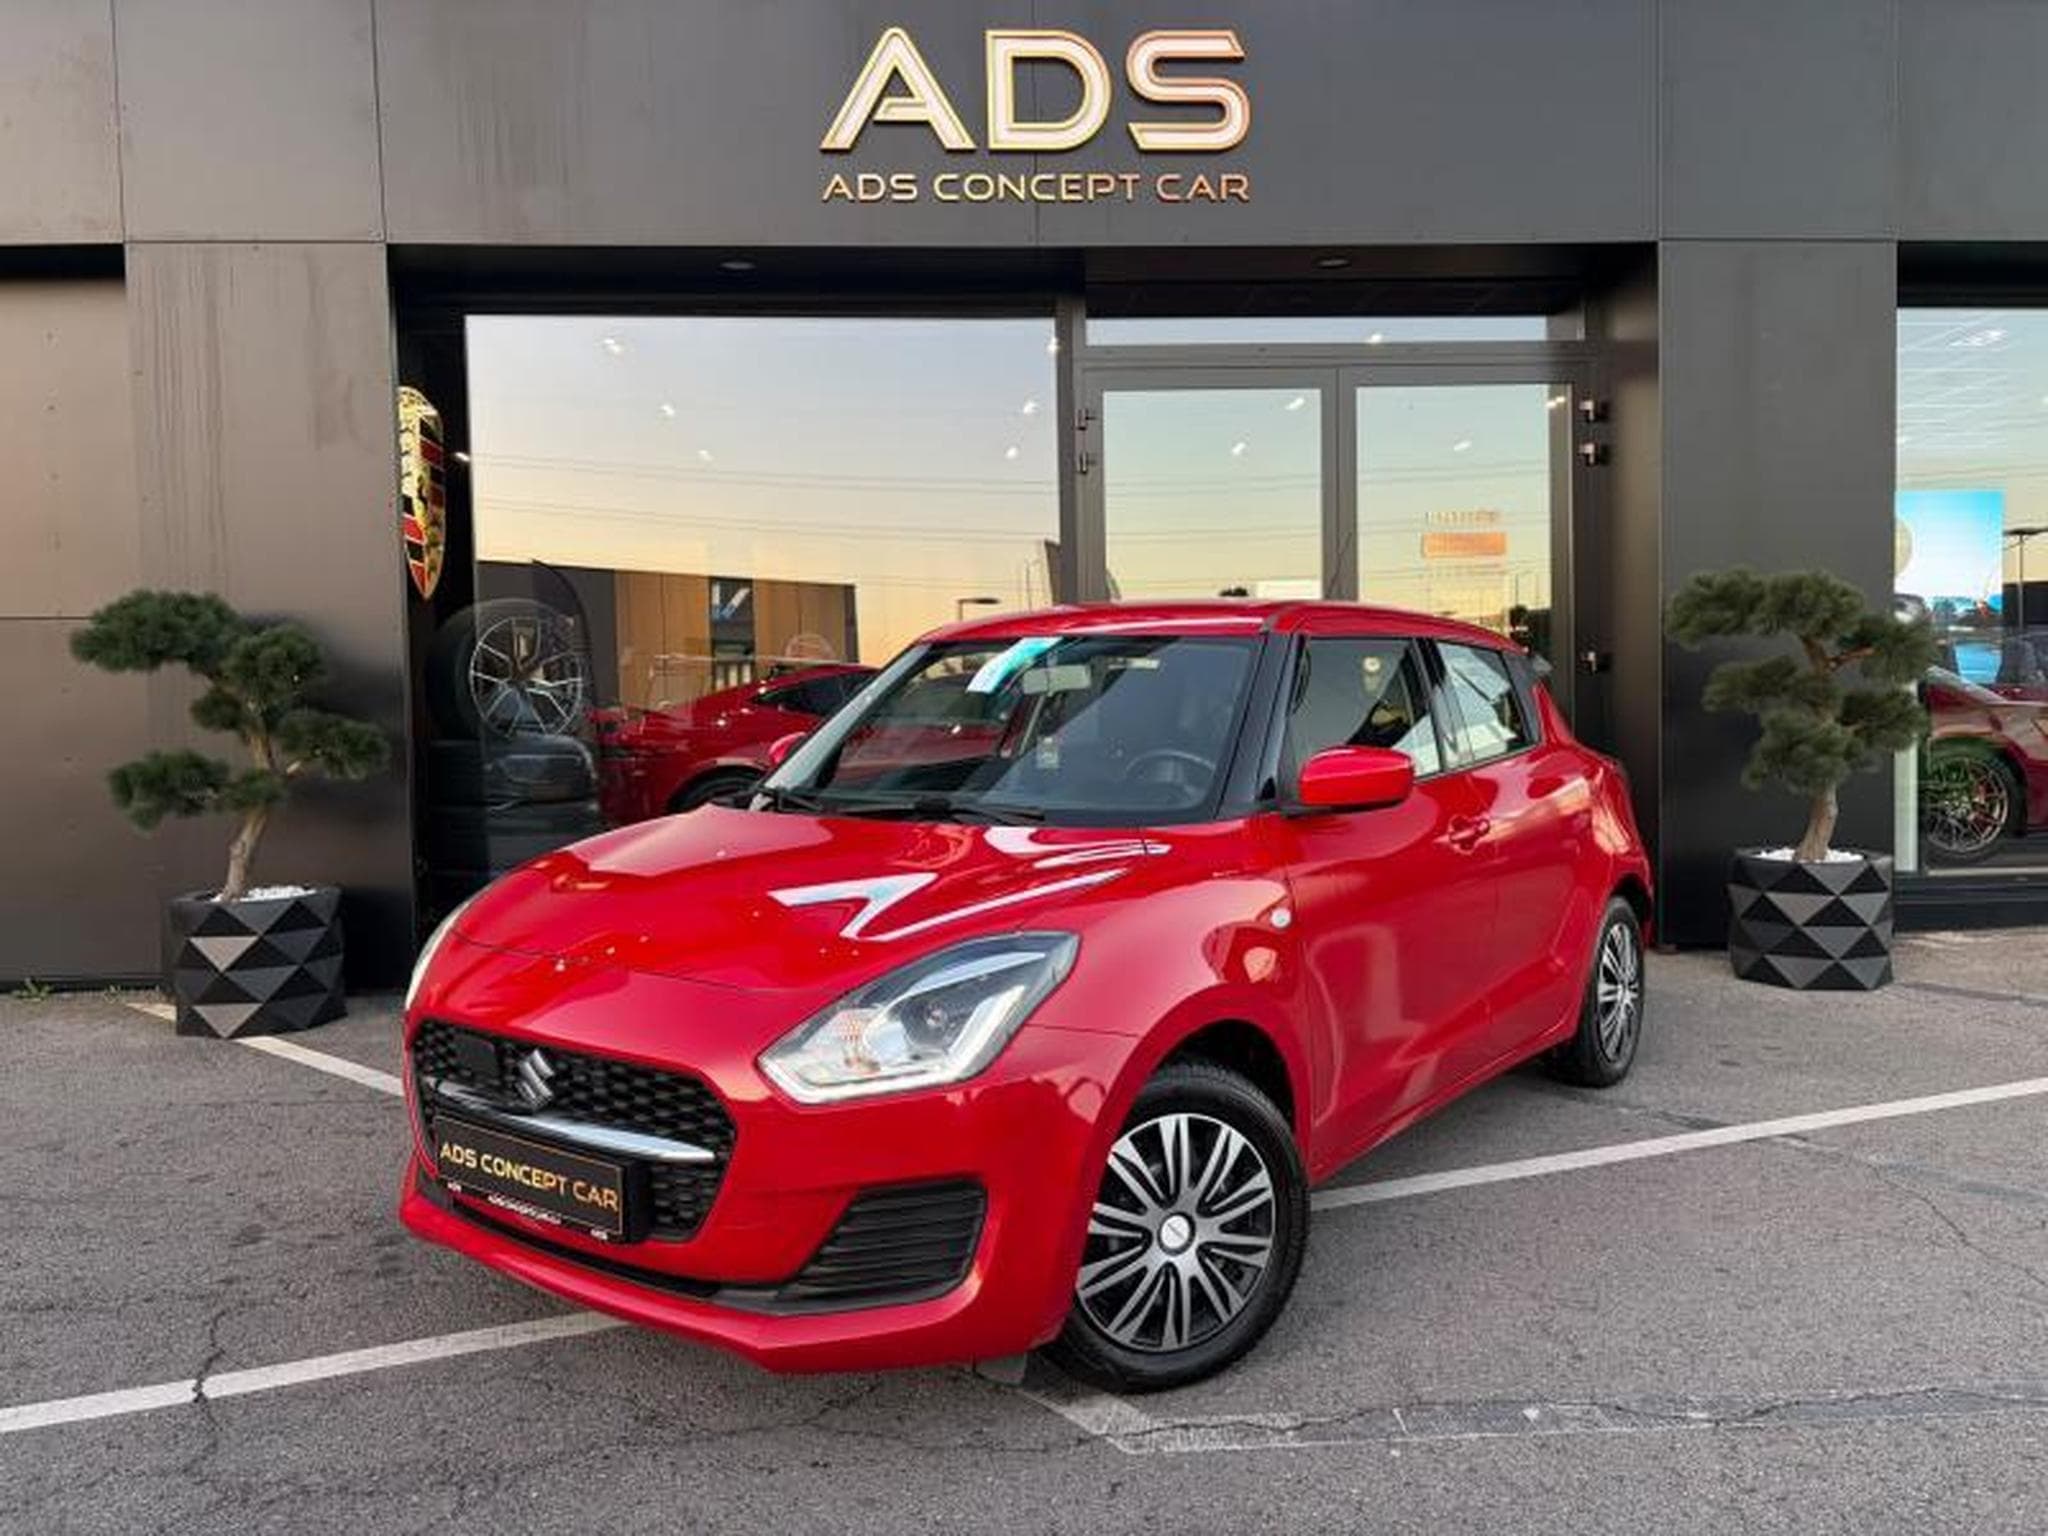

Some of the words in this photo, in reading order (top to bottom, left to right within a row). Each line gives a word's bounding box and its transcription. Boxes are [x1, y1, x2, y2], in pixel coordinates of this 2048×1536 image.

[819, 26, 1251, 151] ADS
[822, 173, 918, 201] ADS
[933, 173, 1141, 201] CONCEPT
[1156, 173, 1250, 201] CAR
[439, 1141, 478, 1169] ADS
[480, 1153, 568, 1196] CONCEPT
[572, 1180, 618, 1212] CAR
